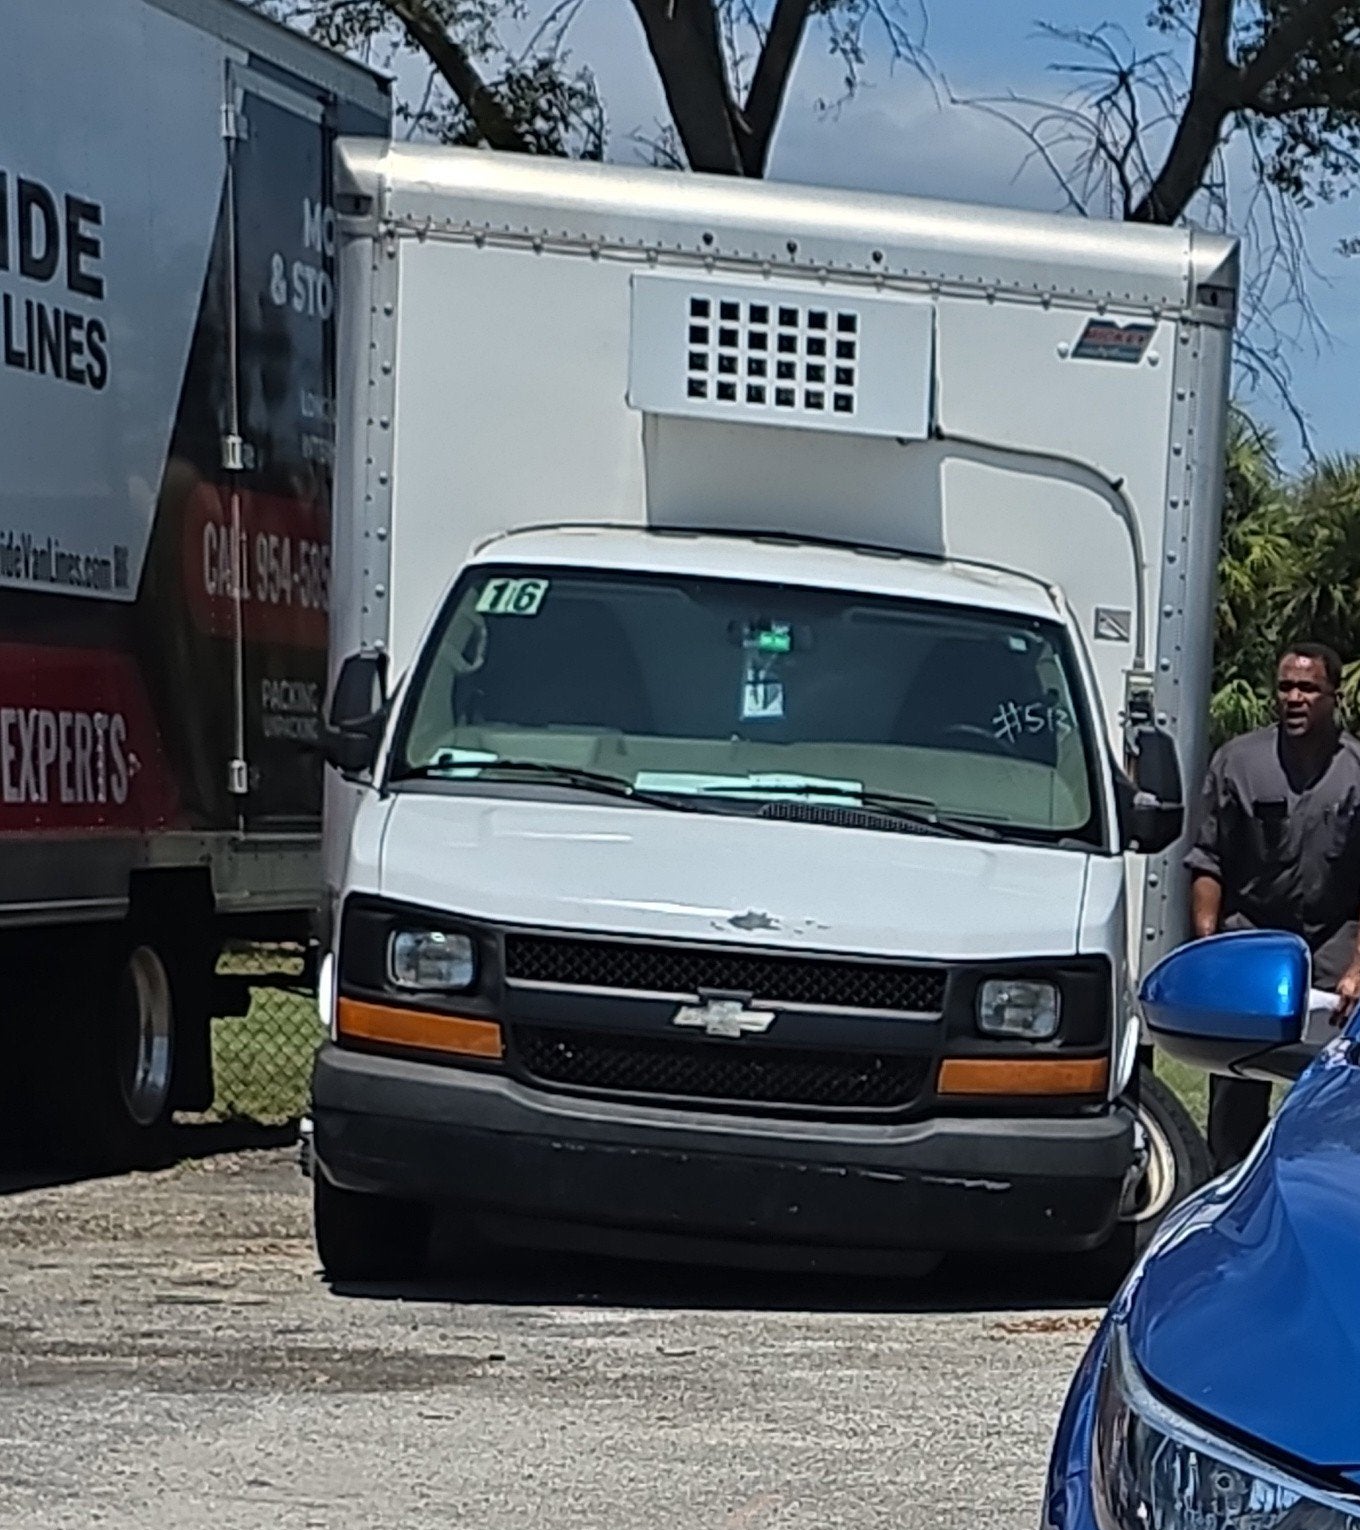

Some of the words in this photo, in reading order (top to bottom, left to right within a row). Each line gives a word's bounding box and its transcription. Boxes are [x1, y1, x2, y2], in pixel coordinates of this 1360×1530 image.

[271, 253, 287, 305] &
[3, 292, 108, 391] LINES
[1, 708, 128, 804] EXPERTS
